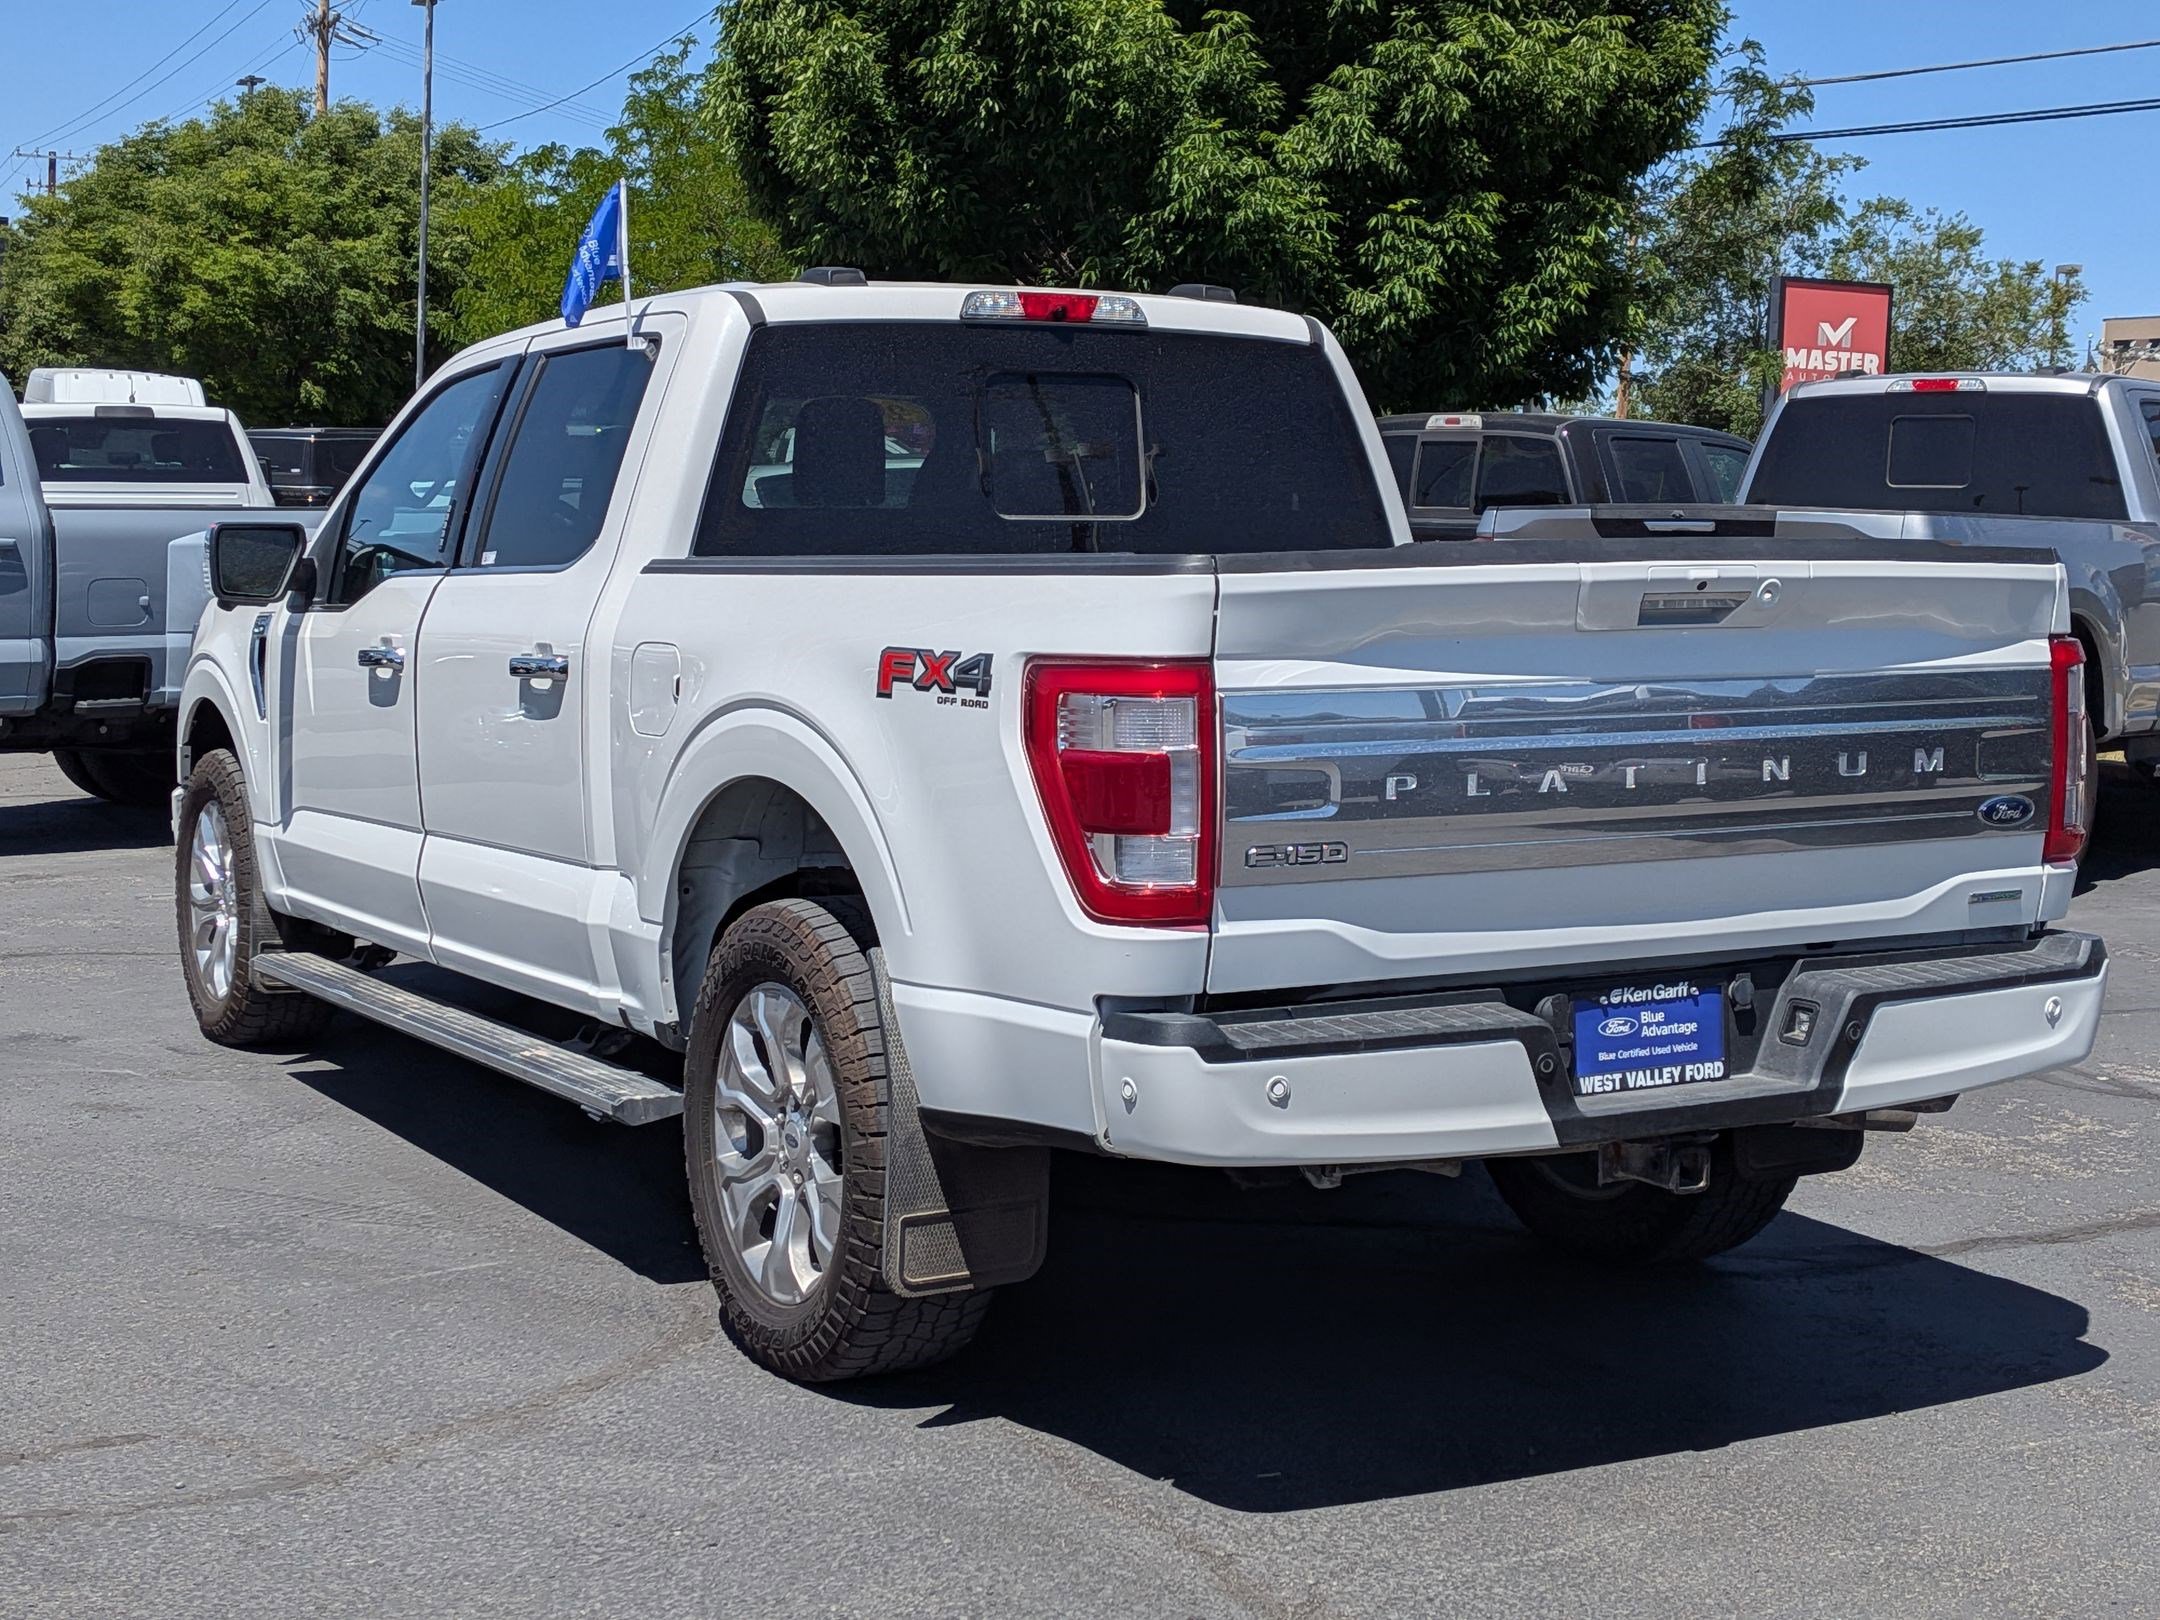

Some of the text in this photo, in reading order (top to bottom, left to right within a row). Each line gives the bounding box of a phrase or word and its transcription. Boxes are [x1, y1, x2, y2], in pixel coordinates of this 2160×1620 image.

[588, 239, 601, 266] Blue
[579, 244, 596, 304] Advanta
[1786, 347, 1880, 375] MASTER
[876, 646, 994, 698] FX4
[936, 695, 989, 709] OFF ROAD
[1385, 747, 1945, 801] PLATINUM
[1992, 802, 2024, 821] Ford
[1244, 841, 1349, 868] F-150
[1653, 981, 1689, 1001] Garff
[1605, 1020, 1631, 1034] Ford
[1640, 1011, 1665, 1024] Blue
[1641, 1021, 1698, 1037] Advantage
[1598, 1042, 1698, 1061] Blue Certified Used Vehicle
[1579, 1060, 1725, 1094] WEST VALLEY FORD
